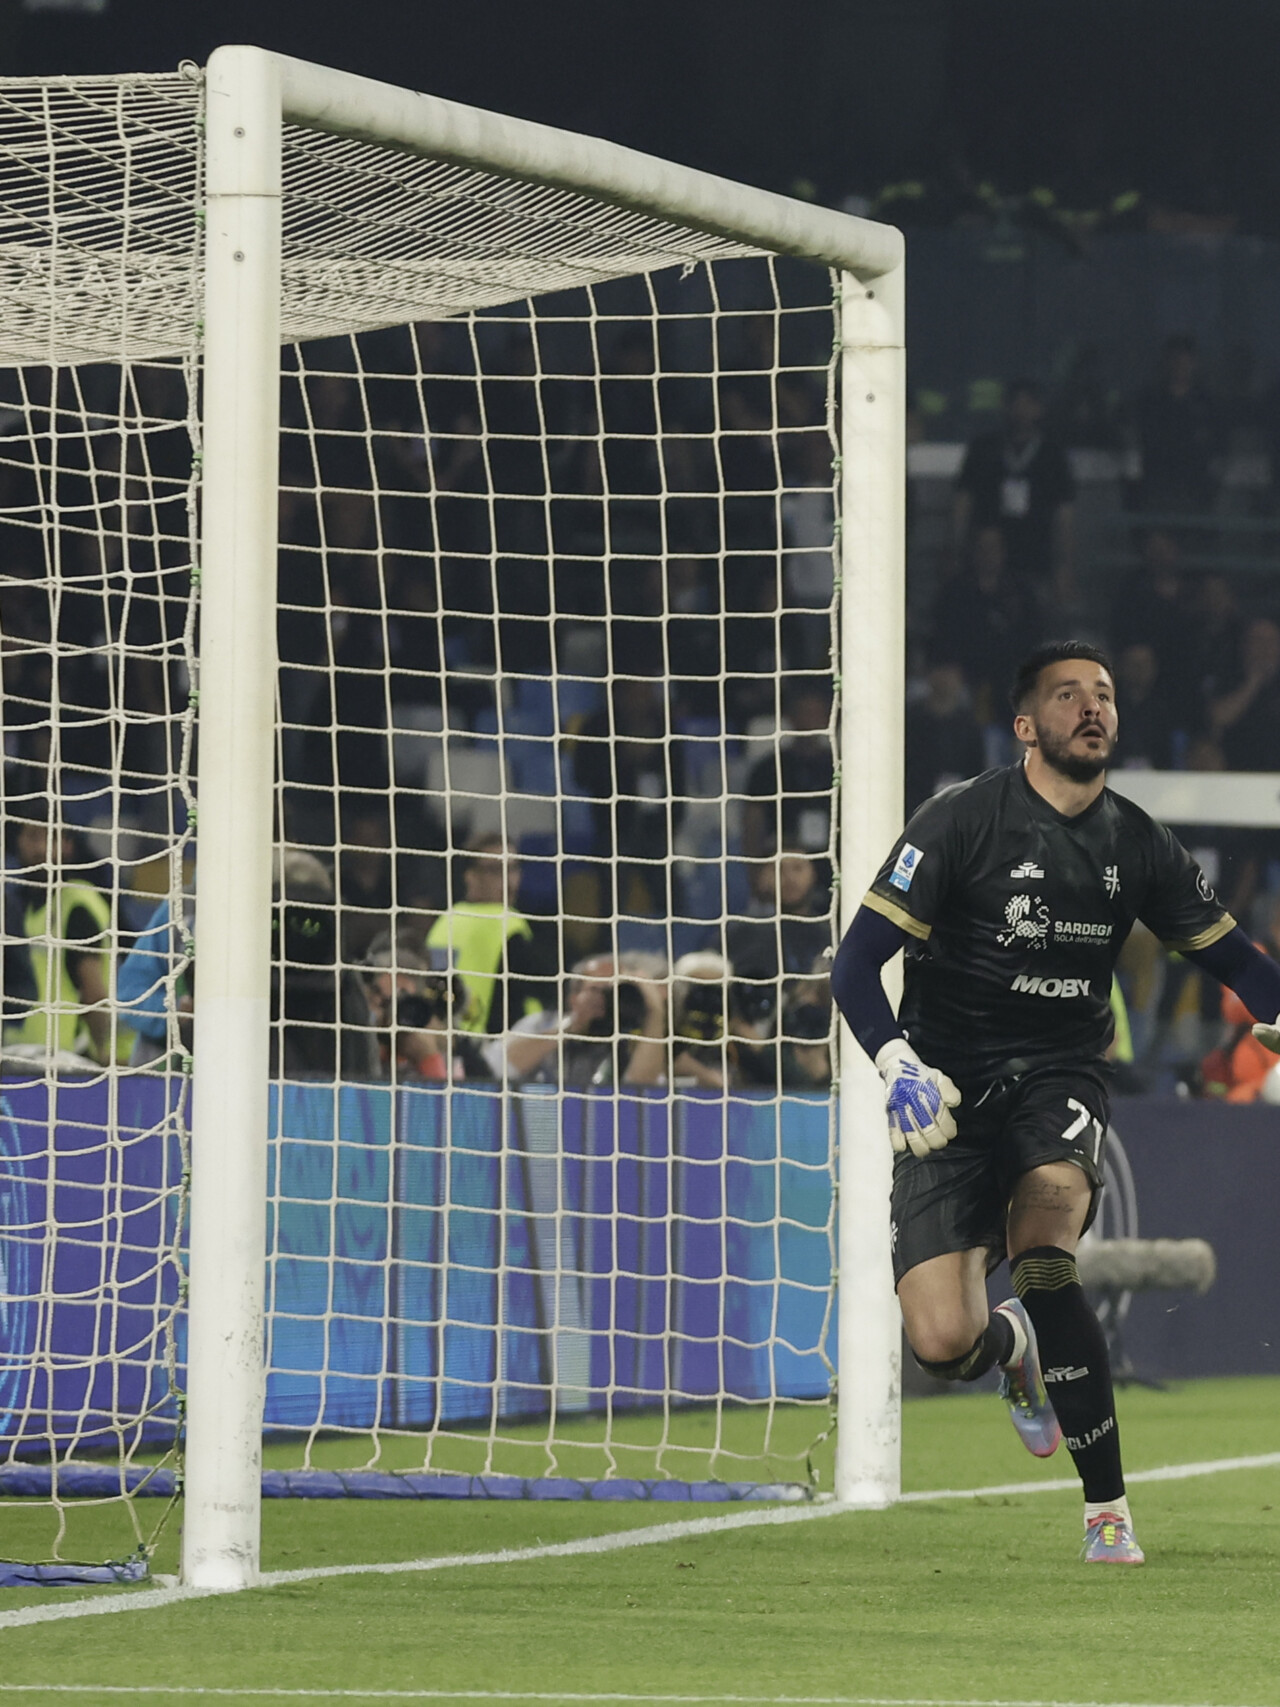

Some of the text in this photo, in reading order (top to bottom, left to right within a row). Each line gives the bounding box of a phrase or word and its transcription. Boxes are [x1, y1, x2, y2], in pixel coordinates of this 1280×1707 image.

[1054, 921, 1113, 937] SARDEGN
[1010, 974, 1091, 998] MOBY
[1063, 1416, 1114, 1451] GLIARI
